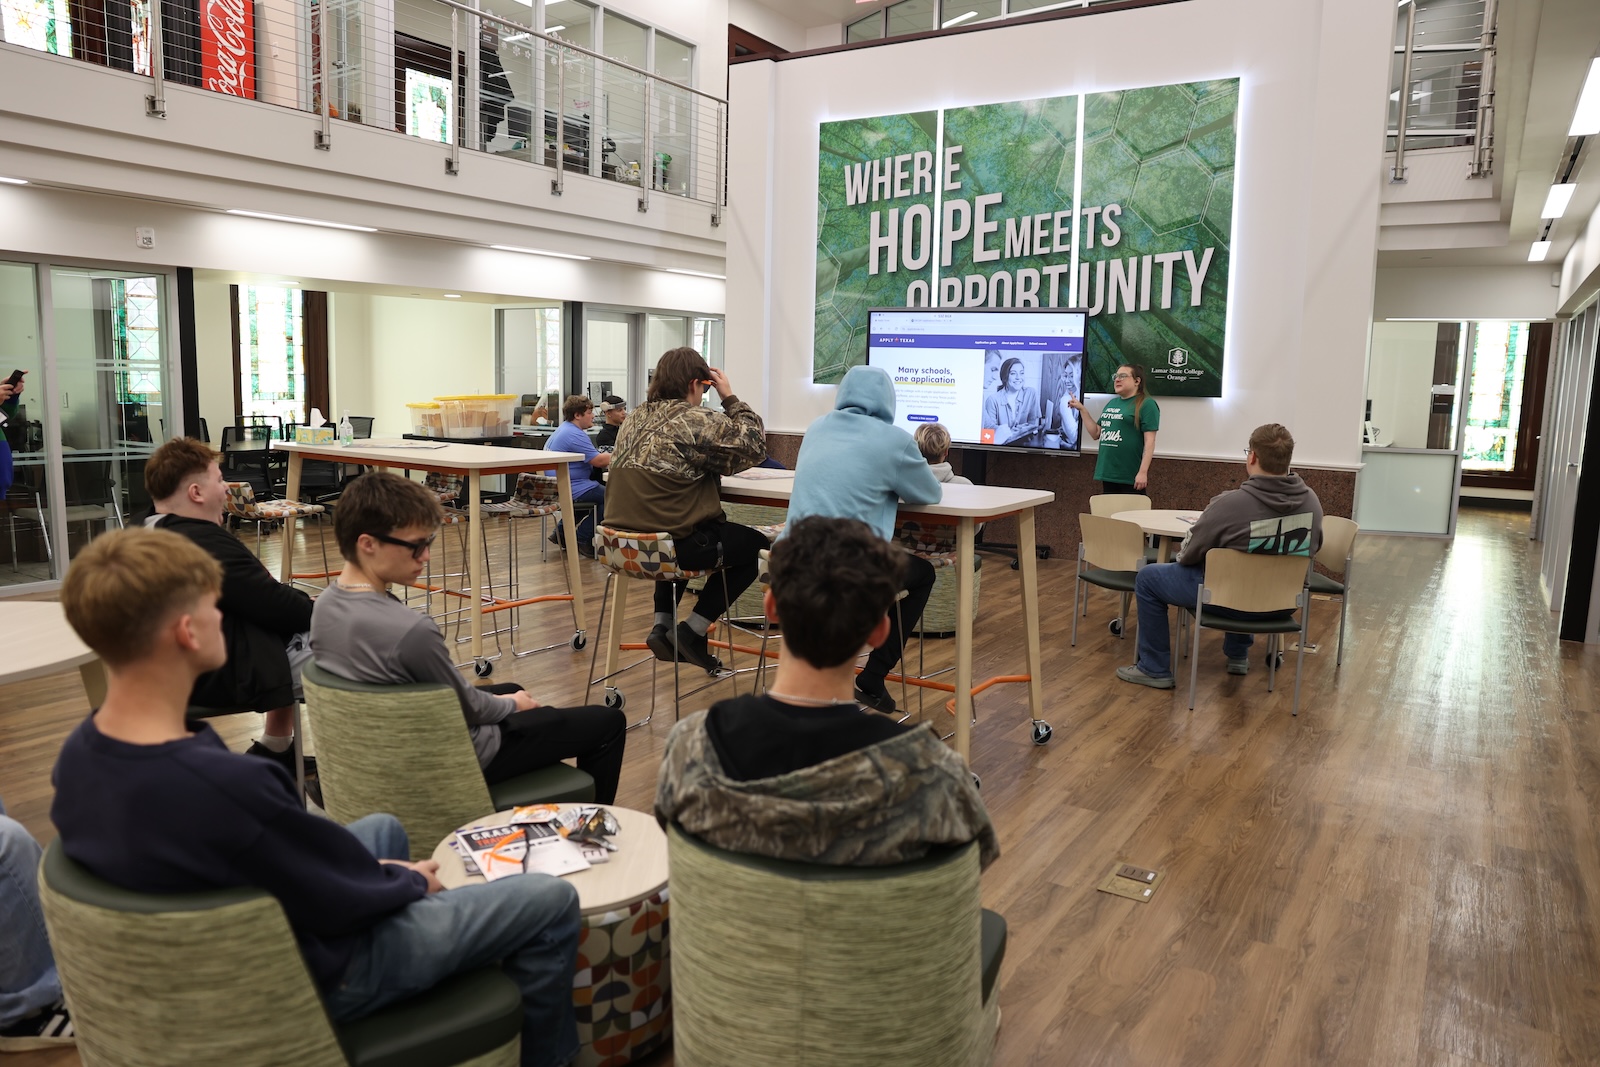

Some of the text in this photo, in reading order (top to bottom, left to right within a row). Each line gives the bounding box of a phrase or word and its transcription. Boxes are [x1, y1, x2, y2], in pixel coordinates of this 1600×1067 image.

[844, 145, 963, 206] WHERE
[869, 192, 1122, 276] HOPE MEETS
[898, 366, 953, 376] Many schools,
[1183, 368, 1204, 376] College
[910, 375, 956, 384] application
